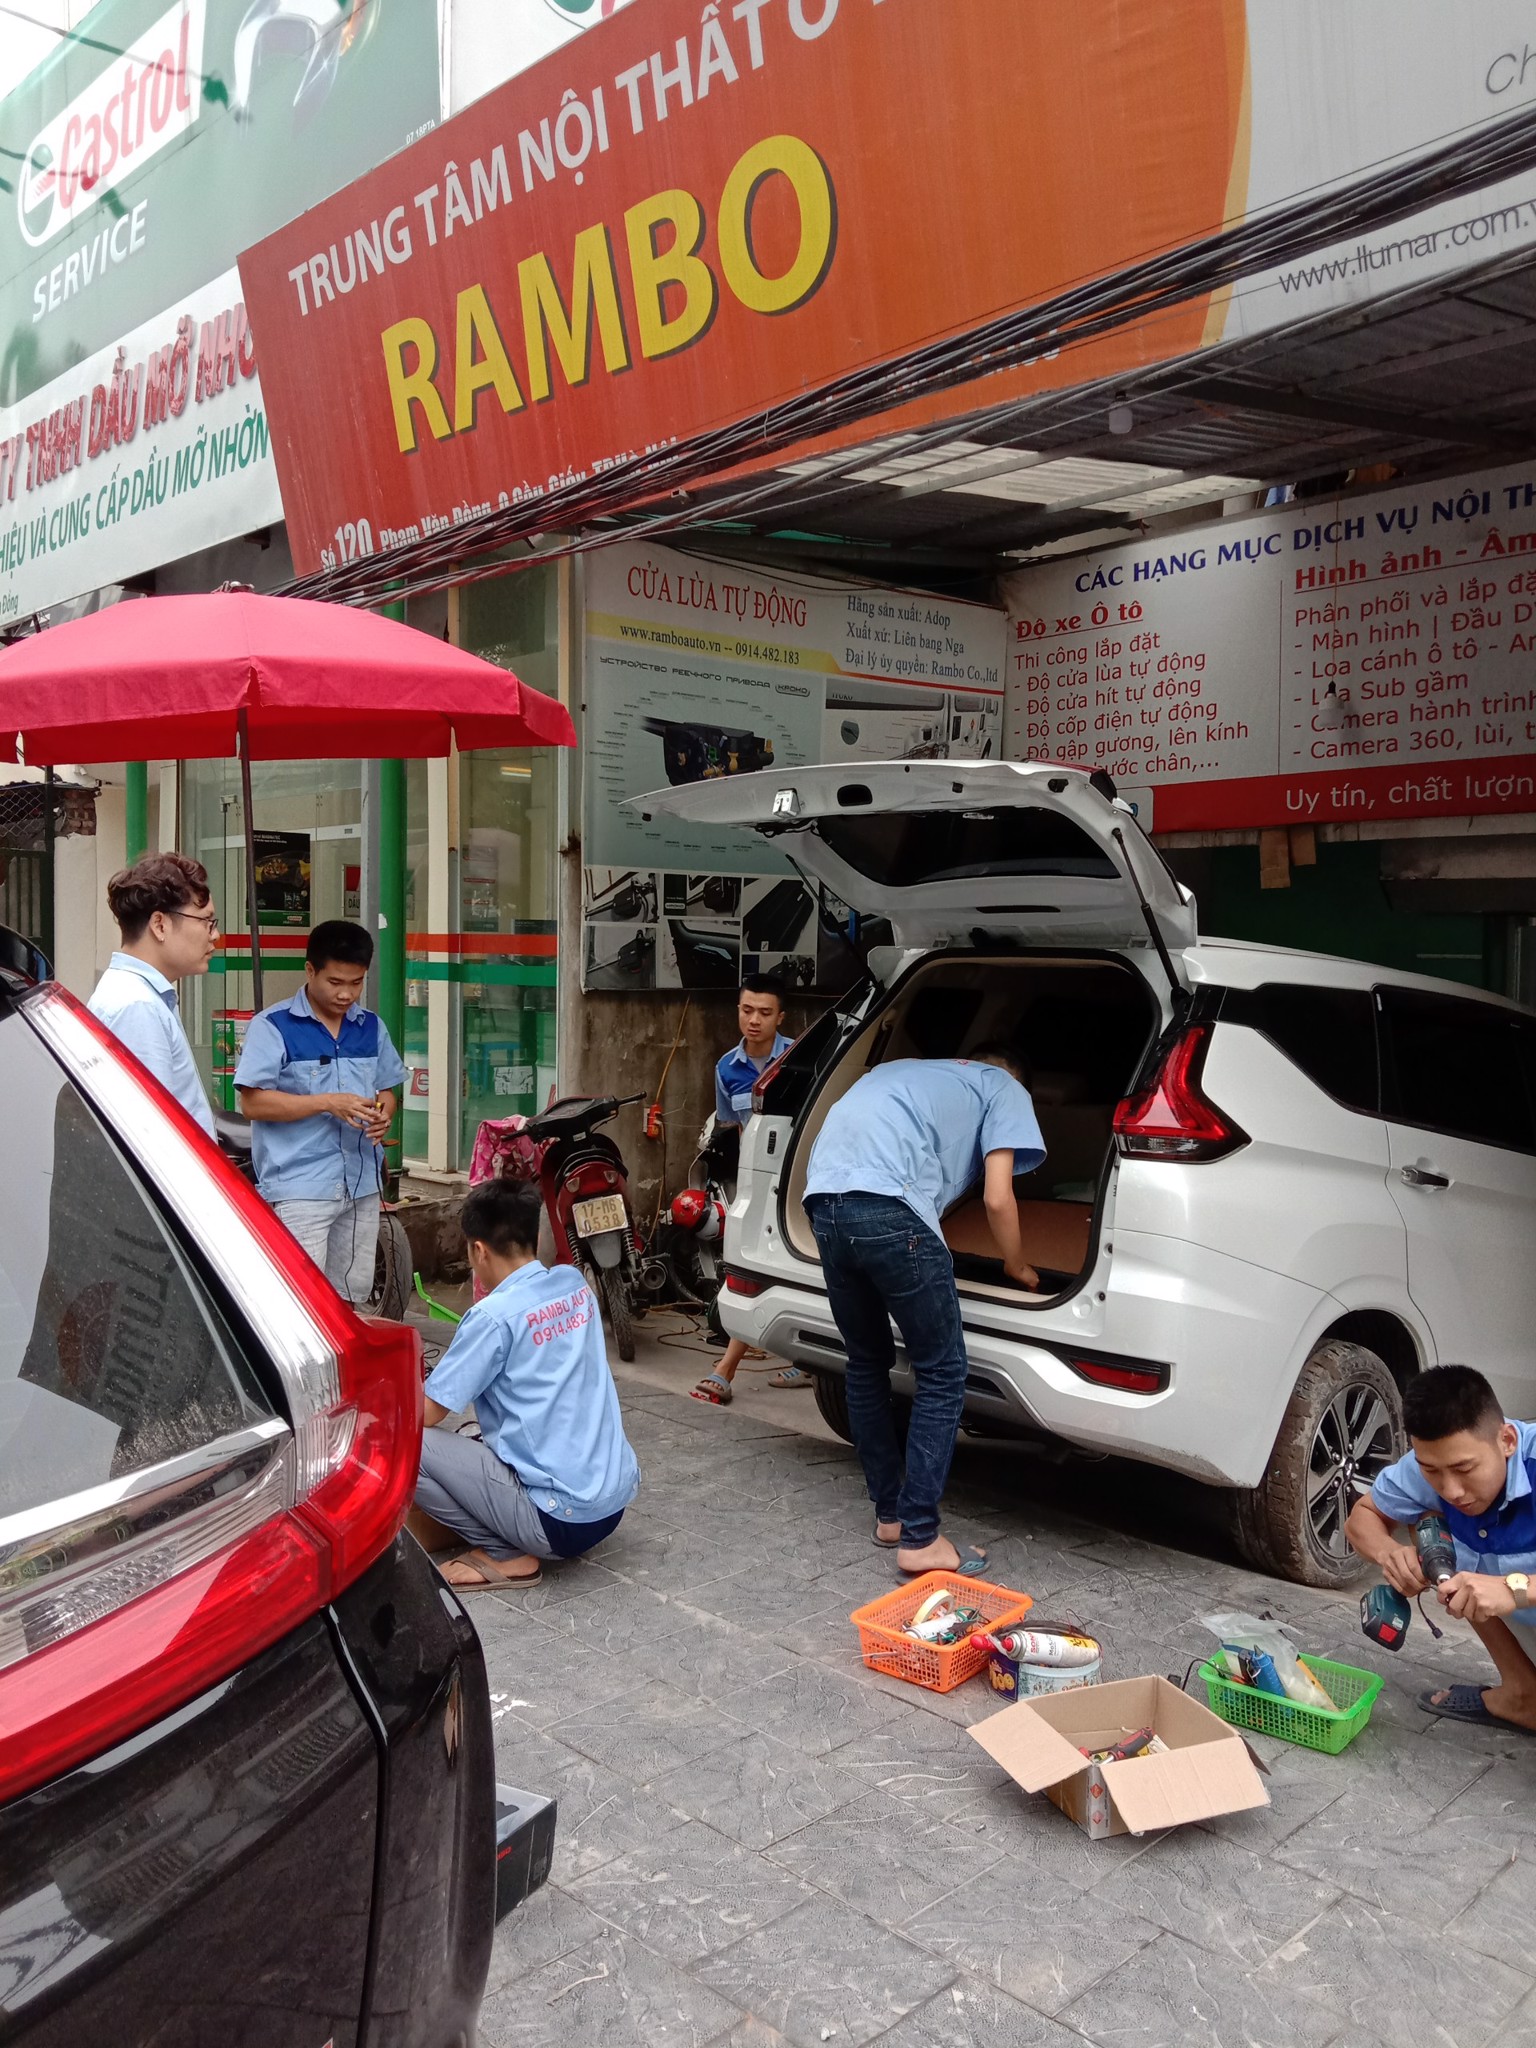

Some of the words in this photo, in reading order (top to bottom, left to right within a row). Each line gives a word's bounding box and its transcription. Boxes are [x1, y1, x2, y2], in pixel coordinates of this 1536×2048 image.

[58, 9, 192, 210] Castrol
[288, 206, 413, 317] TRUNG
[414, 144, 513, 247] TÂM
[517, 86, 611, 192] NỘI
[614, 0, 771, 136] THẤT
[32, 199, 148, 324] SERVICE
[379, 135, 836, 456] RAMBO
[26, 395, 88, 492] TNHH
[87, 345, 144, 460] DẦU
[31, 507, 47, 560] VÀ
[49, 492, 92, 551] CUNG
[95, 463, 130, 530] CẤP
[130, 445, 169, 516] DẦU
[172, 423, 208, 498] MỠ
[335, 517, 375, 568] 120
[1075, 564, 1124, 593] CÁC
[1133, 549, 1207, 583] HẠNG
[1216, 533, 1282, 566] MỤC
[1293, 516, 1365, 551] DỊCH
[1376, 505, 1419, 535] VỤ
[1432, 488, 1491, 524] NỘI
[1295, 559, 1367, 590] Hình
[1380, 545, 1442, 575] ảnh
[627, 560, 673, 604] CỬA
[677, 571, 718, 612] LÙA
[722, 584, 750, 622] TỰ
[753, 586, 807, 628] ĐỘNG
[1295, 602, 1350, 628] Phân
[1360, 591, 1410, 622] phối
[1421, 584, 1448, 607] và
[1460, 577, 1497, 603] lắp
[846, 620, 872, 641] Xuất
[894, 629, 916, 648] Liên
[919, 633, 942, 654] bang
[945, 638, 964, 656] Nga
[924, 610, 951, 630] Adop
[1016, 618, 1047, 640] Độ
[1055, 614, 1082, 633] xe
[1091, 601, 1109, 626] Ô
[1119, 600, 1144, 622] tô
[1312, 628, 1359, 652] Màn
[1369, 619, 1420, 644] hình
[1450, 607, 1502, 632] Đầu
[1514, 602, 1536, 624] D
[620, 624, 721, 653] www.ramboauto.vn
[735, 641, 800, 666] 0914.482.183
[846, 648, 864, 667] Đại
[867, 650, 877, 670] lý
[931, 660, 965, 679] Rambo
[1014, 652, 1040, 670] Thi
[1046, 646, 1088, 666] công
[1095, 637, 1122, 659] lắp
[1129, 632, 1161, 655] đặt
[1312, 661, 1351, 679] Loa
[1361, 648, 1417, 672] cánh
[1428, 642, 1442, 664] ô
[1453, 638, 1478, 661] tô
[1027, 673, 1050, 692] Độ
[1057, 668, 1088, 688] cửa
[1095, 665, 1122, 683] lùa
[1130, 660, 1151, 678] tự
[1157, 652, 1206, 675] động
[1361, 677, 1405, 700] Sub
[1416, 670, 1469, 698] gầm
[1027, 696, 1050, 715] Độ
[1057, 692, 1088, 711] cửa
[1095, 687, 1119, 706] hít
[1125, 684, 1147, 704] tự
[1153, 677, 1201, 698] động
[1311, 708, 1399, 733] Cmera
[1410, 696, 1471, 723] hành
[1027, 720, 1050, 739] Độ
[1094, 710, 1132, 731] điện
[1140, 707, 1162, 727] tự
[1168, 701, 1218, 722] động
[1095, 735, 1161, 759] gương,
[1169, 727, 1197, 746] lên
[1206, 722, 1249, 743] kính
[1310, 736, 1399, 760] Camera
[1409, 728, 1463, 751] 360,
[1475, 723, 1513, 747] lùi,
[1286, 788, 1320, 815] Uy
[1330, 783, 1376, 810] tín,
[1389, 776, 1453, 804] chất
[581, 1199, 617, 1218] 17-M6
[583, 1213, 620, 1232] 0538
[525, 1299, 571, 1329] RAMBO
[571, 1286, 591, 1310] AUT
